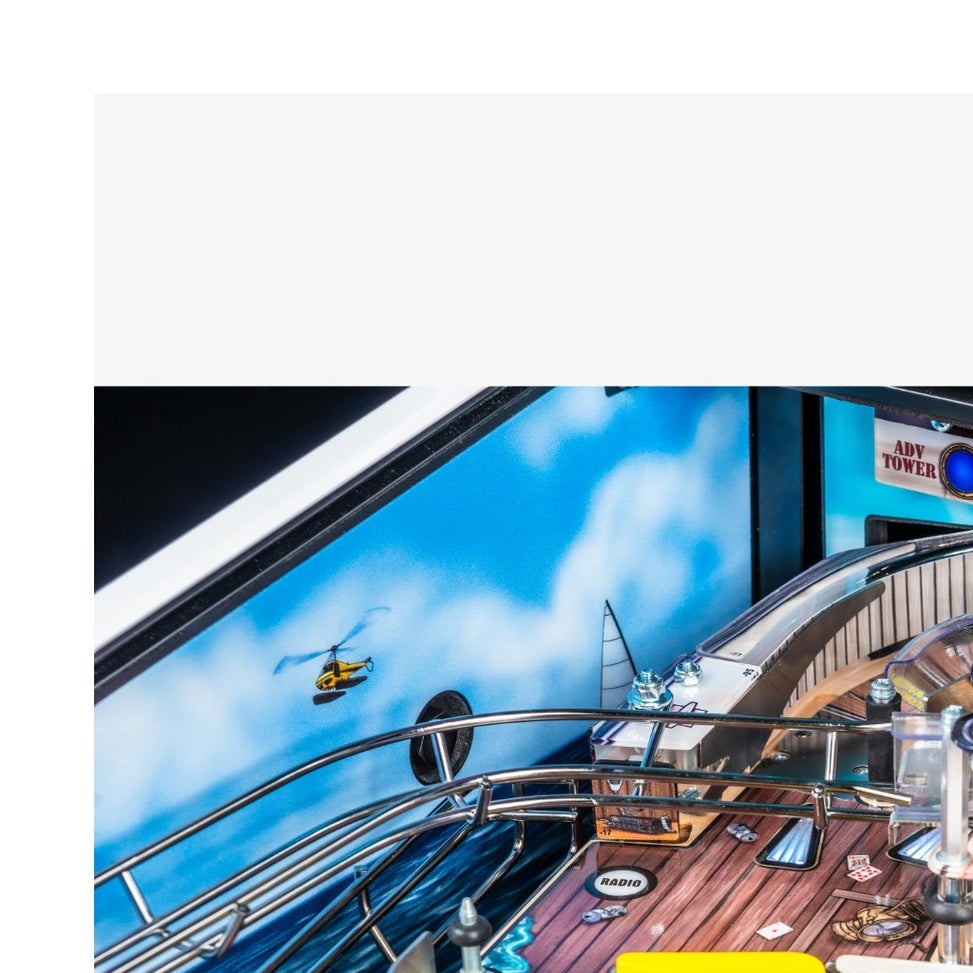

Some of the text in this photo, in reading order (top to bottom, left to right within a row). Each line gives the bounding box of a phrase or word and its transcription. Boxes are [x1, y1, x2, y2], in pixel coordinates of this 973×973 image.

[893, 440, 925, 460] ADV
[882, 453, 937, 480] TOWER
[600, 877, 642, 888] RADIO
